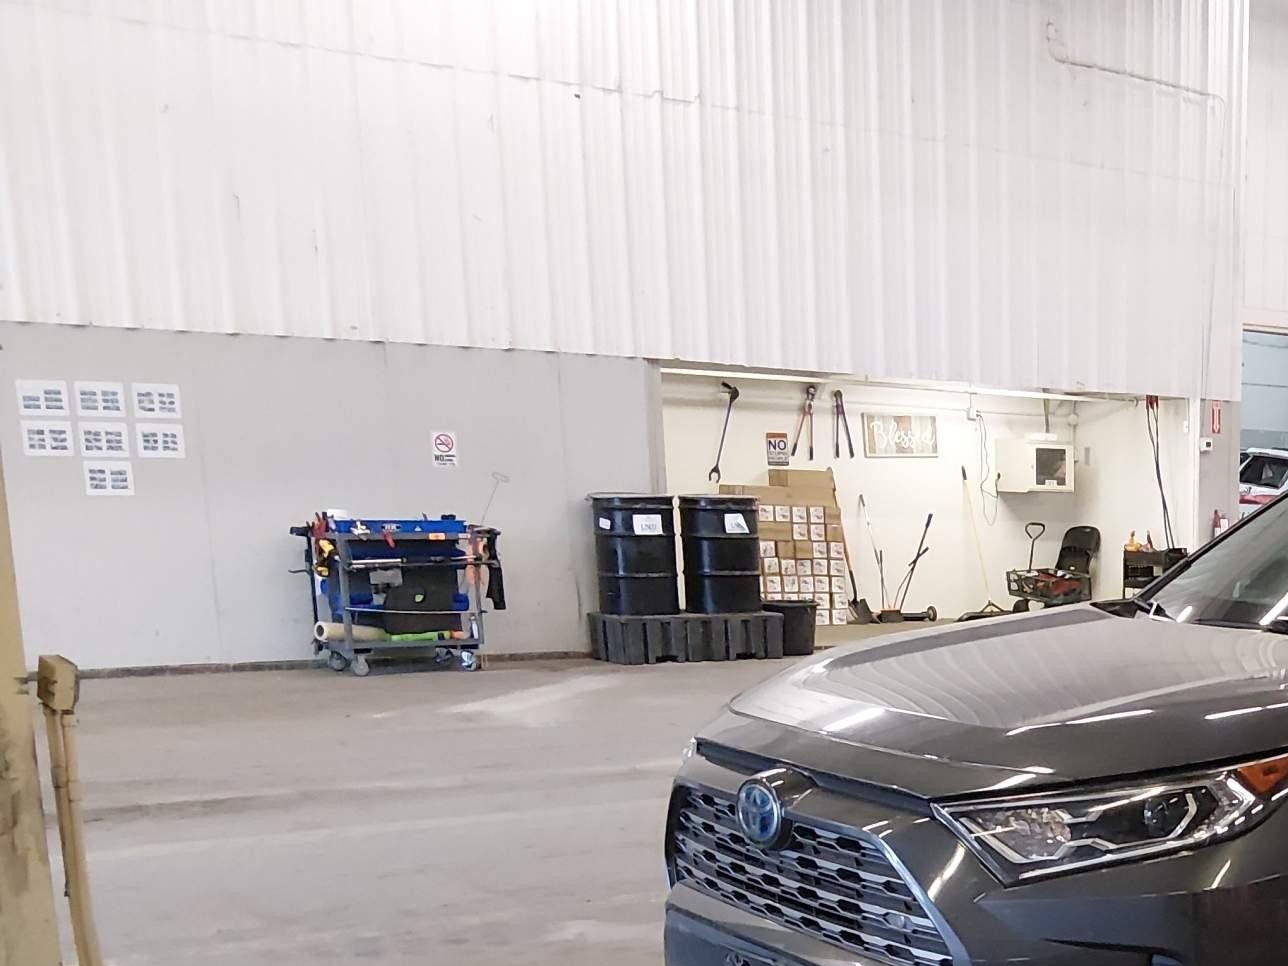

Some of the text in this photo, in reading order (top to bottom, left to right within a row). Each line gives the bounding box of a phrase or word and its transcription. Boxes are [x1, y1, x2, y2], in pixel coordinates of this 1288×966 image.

[870, 418, 935, 450] Blessed
[768, 439, 787, 451] NO
[434, 454, 445, 462] NO
